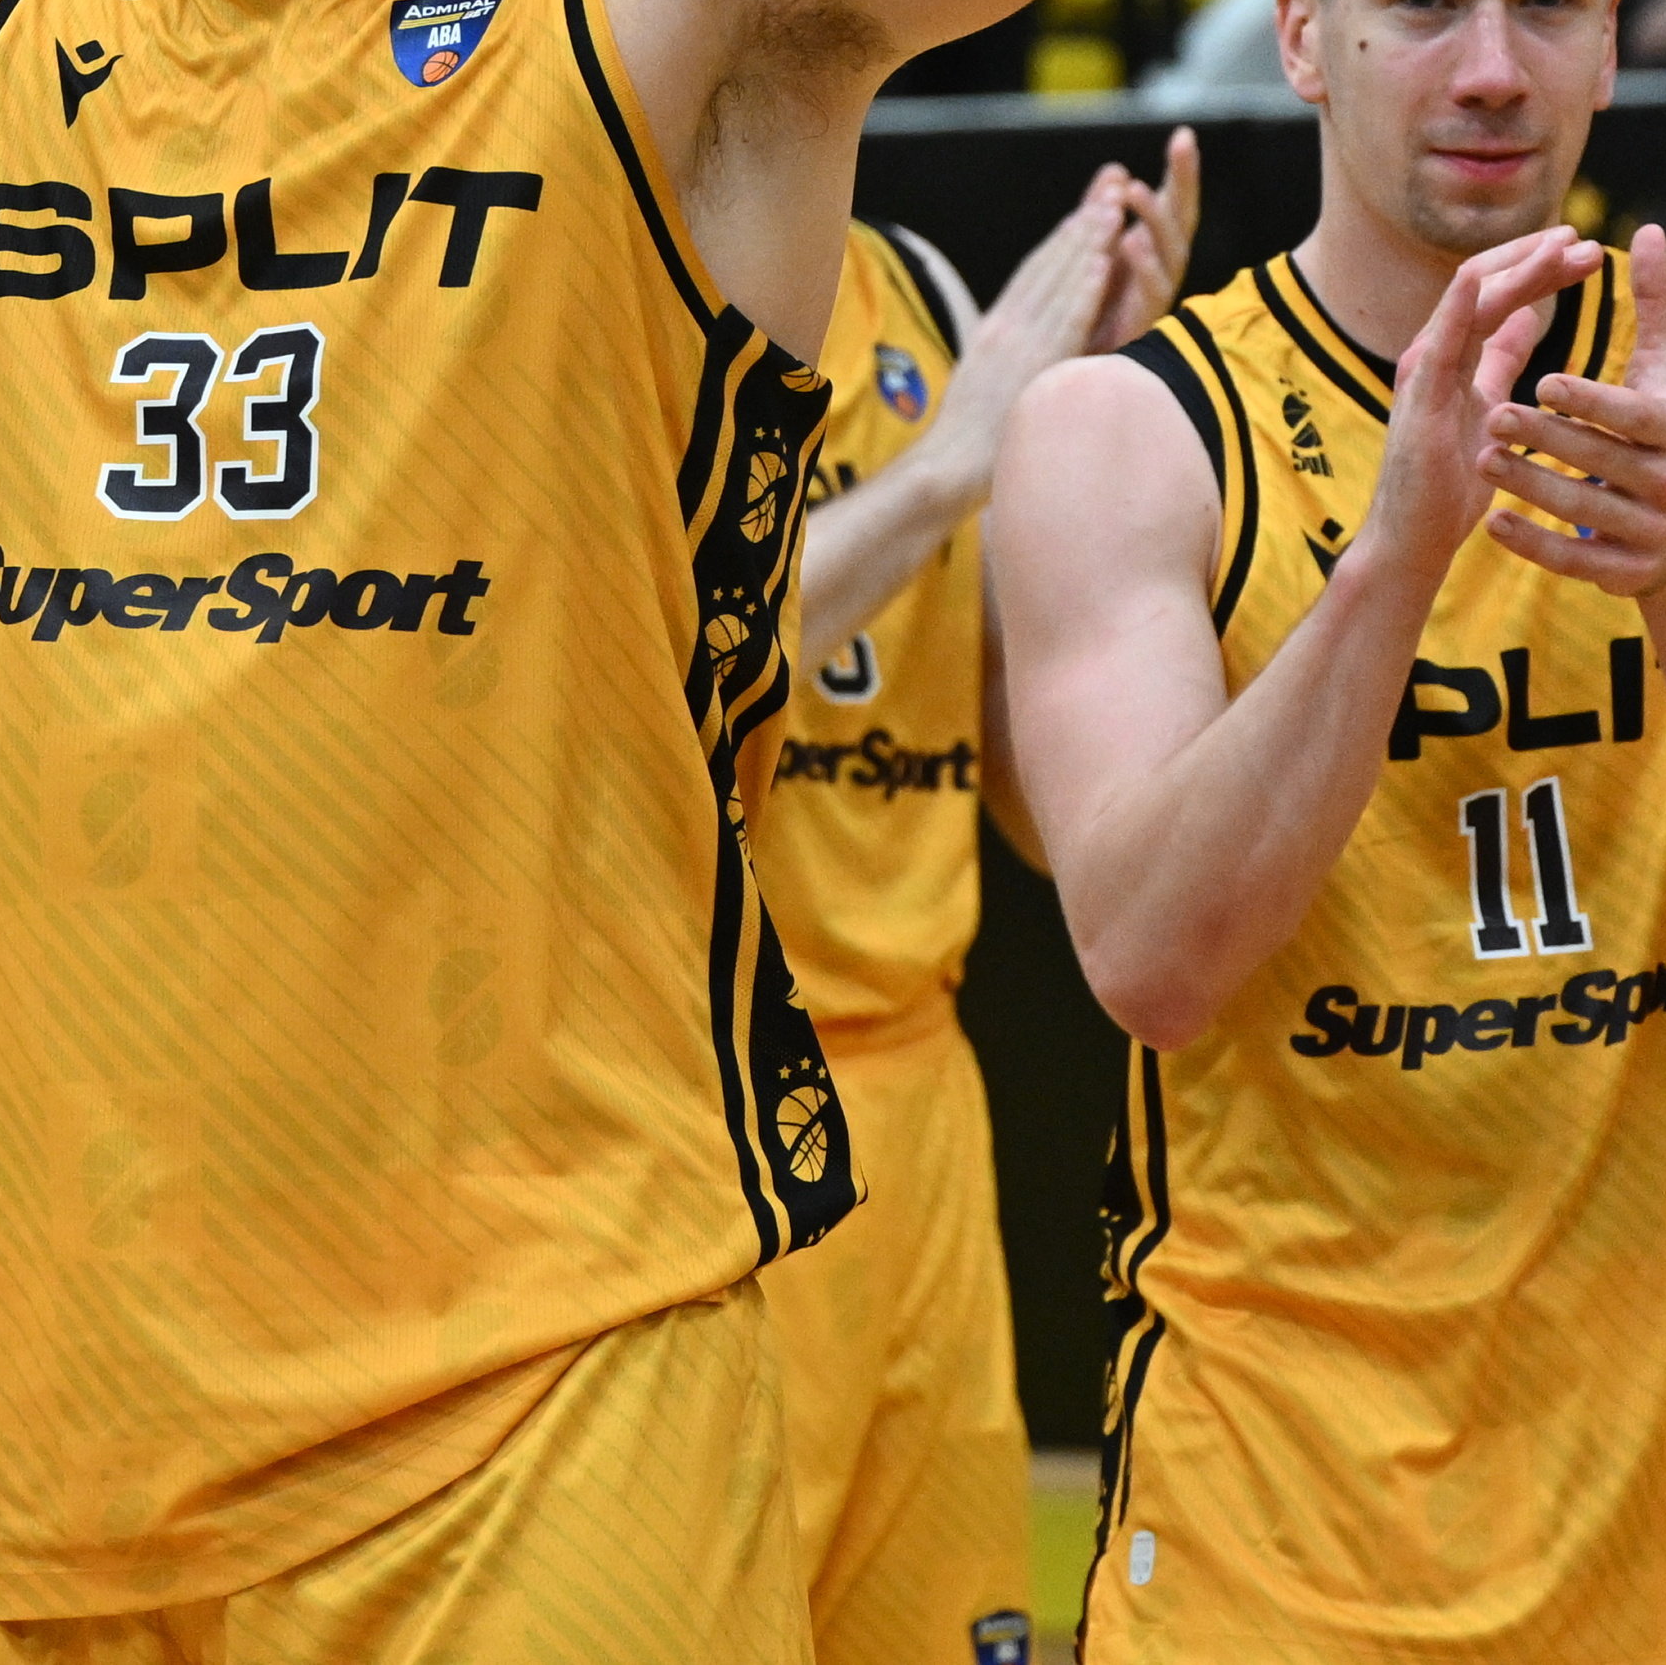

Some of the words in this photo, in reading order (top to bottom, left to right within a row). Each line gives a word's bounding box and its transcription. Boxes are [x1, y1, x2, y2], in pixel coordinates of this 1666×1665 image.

[427, 22, 462, 49] ABA
[95, 321, 325, 521] 33
[1388, 636, 1645, 761] PLI
[1458, 775, 1594, 960] 11
